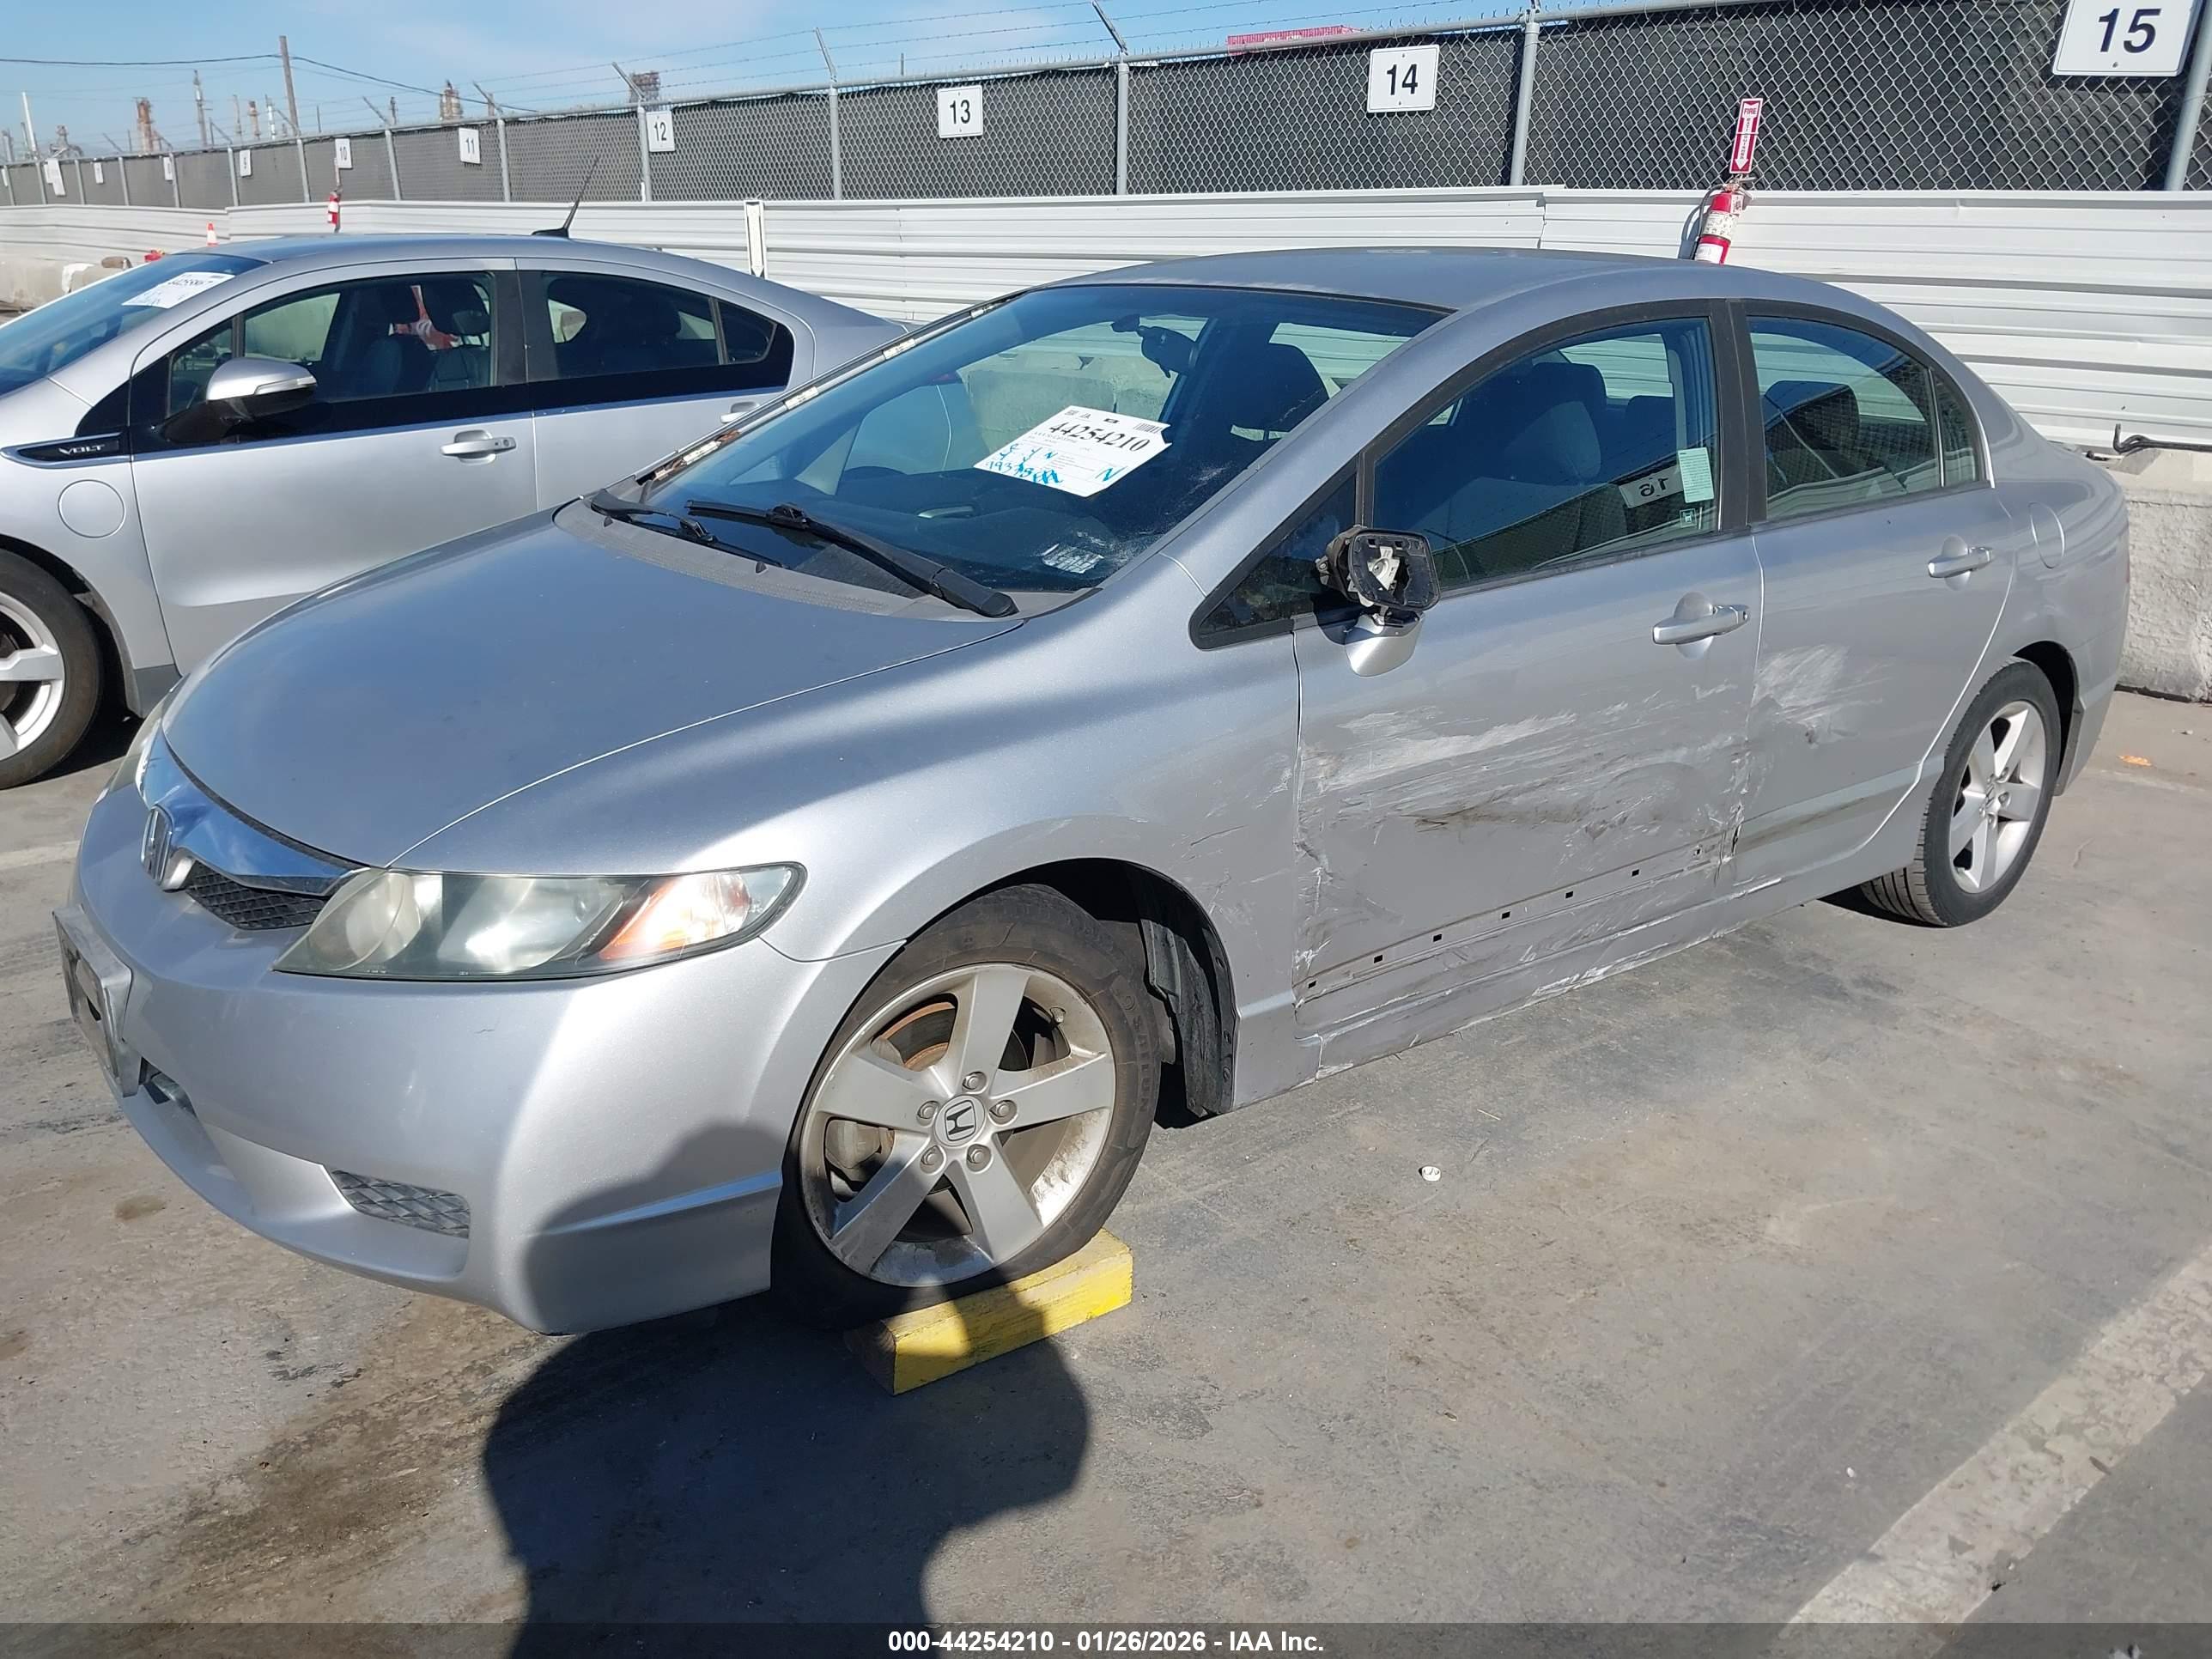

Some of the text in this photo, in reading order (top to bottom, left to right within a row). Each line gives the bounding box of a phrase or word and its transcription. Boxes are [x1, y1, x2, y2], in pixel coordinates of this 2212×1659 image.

[2098, 8, 2162, 53] 15
[1386, 64, 1419, 95] 14
[949, 99, 971, 125] 13
[653, 121, 667, 142] 12
[1740, 117, 1752, 160] EXTIGUISHER
[339, 146, 348, 161] 10
[465, 137, 476, 155] 11
[58, 443, 105, 455] VOLT
[1048, 422, 1152, 452] 44254210
